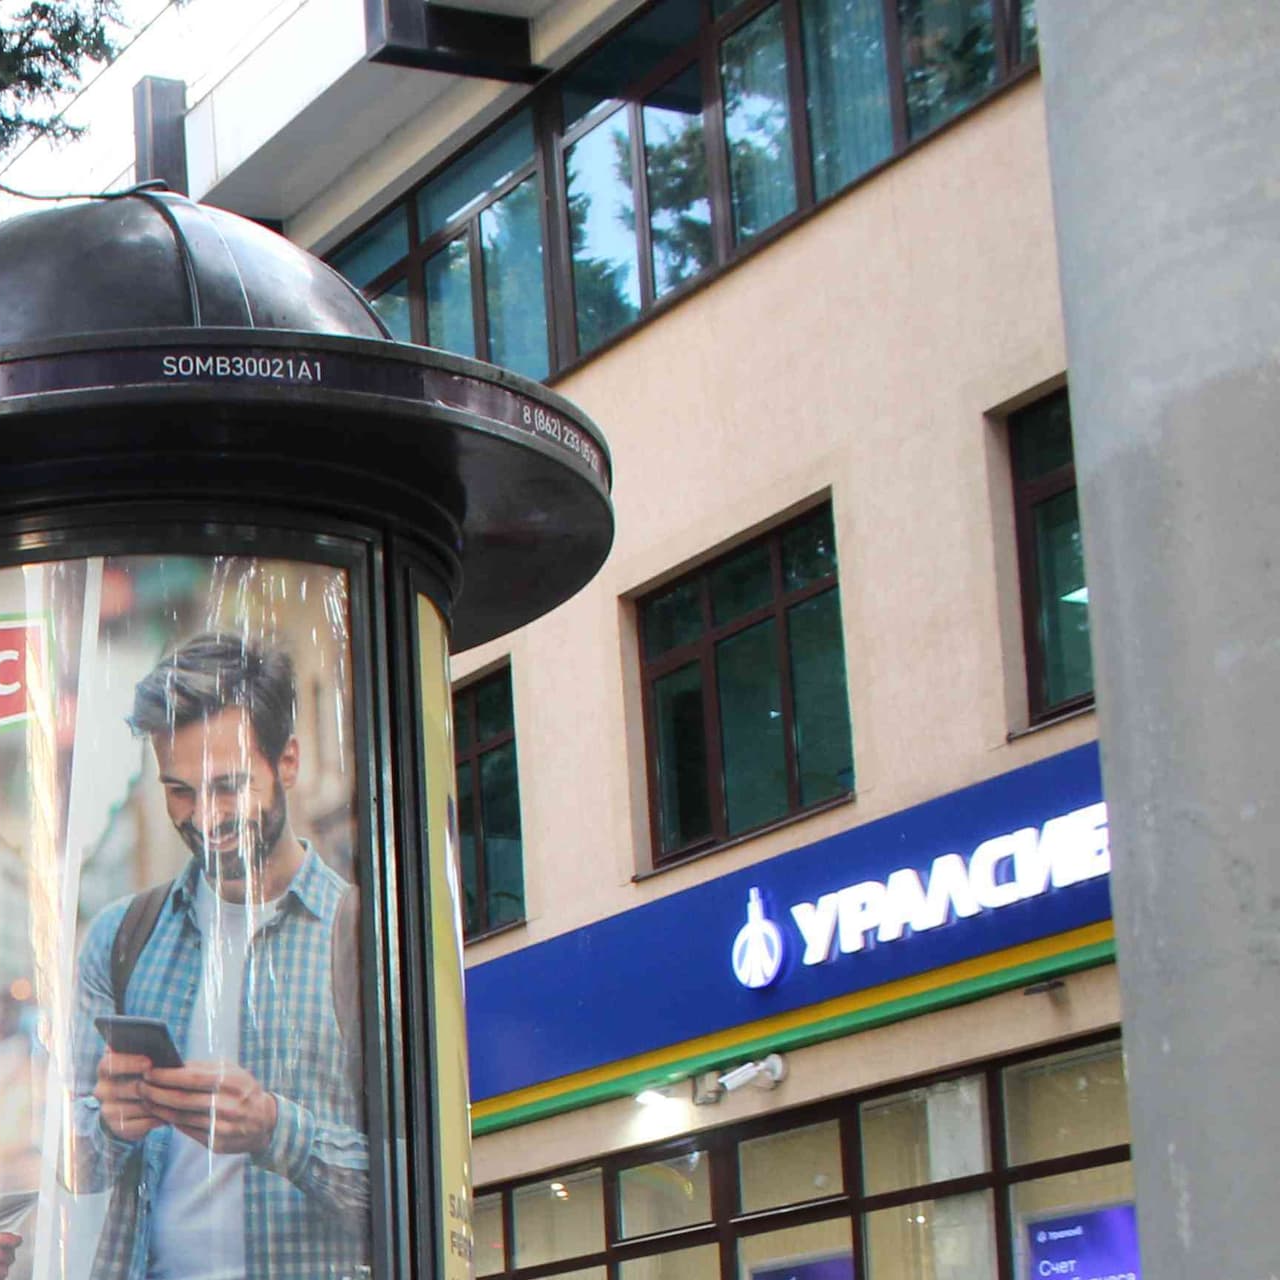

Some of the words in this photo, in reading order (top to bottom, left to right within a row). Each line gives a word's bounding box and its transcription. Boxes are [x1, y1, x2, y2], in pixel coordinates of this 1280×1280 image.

[162, 355, 322, 382] SOMB30021A1
[522, 405, 532, 424] 8
[534, 408, 562, 442] (862)
[1039, 1260, 1077, 1277] Счет
